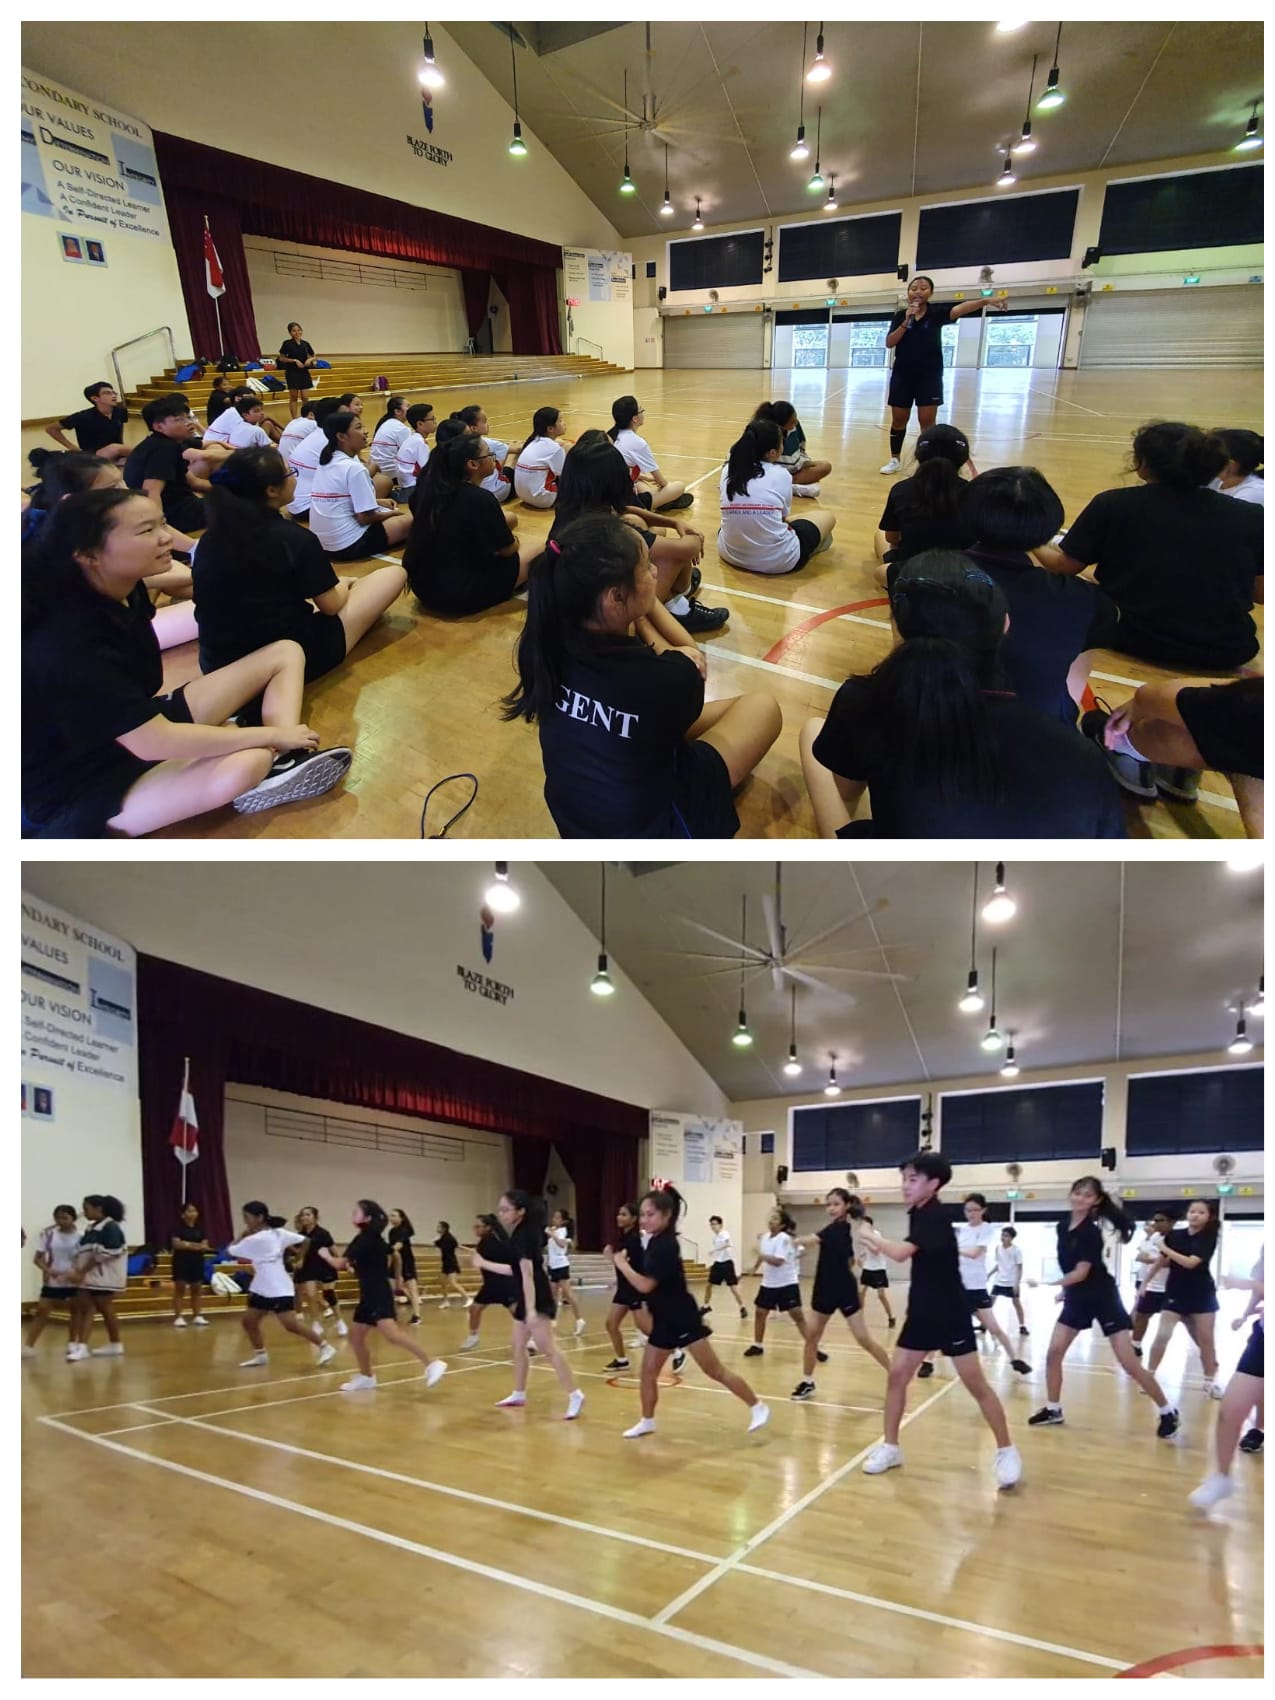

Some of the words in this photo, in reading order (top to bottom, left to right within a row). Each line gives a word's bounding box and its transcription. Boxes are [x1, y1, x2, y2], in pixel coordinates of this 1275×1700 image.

[47, 112, 95, 140] VALUES
[93, 109, 142, 138] SCHOOL
[425, 151, 447, 167] GLORY
[53, 160, 83, 179] OUR
[85, 171, 126, 191] VISION
[58, 181, 66, 190] A
[66, 182, 121, 204] Self-Directed
[123, 200, 151, 214] Learner
[61, 193, 68, 201] A
[69, 196, 109, 213] Confident
[112, 206, 137, 219] Leader
[119, 220, 160, 237] Excellence
[72, 927, 125, 962] SCHOOL
[49, 1001, 91, 1025] VISION
[25, 1031, 68, 1051] Confident
[71, 1046, 100, 1061] Leader
[86, 1036, 119, 1053] Learner
[77, 1061, 125, 1083] Excellence
